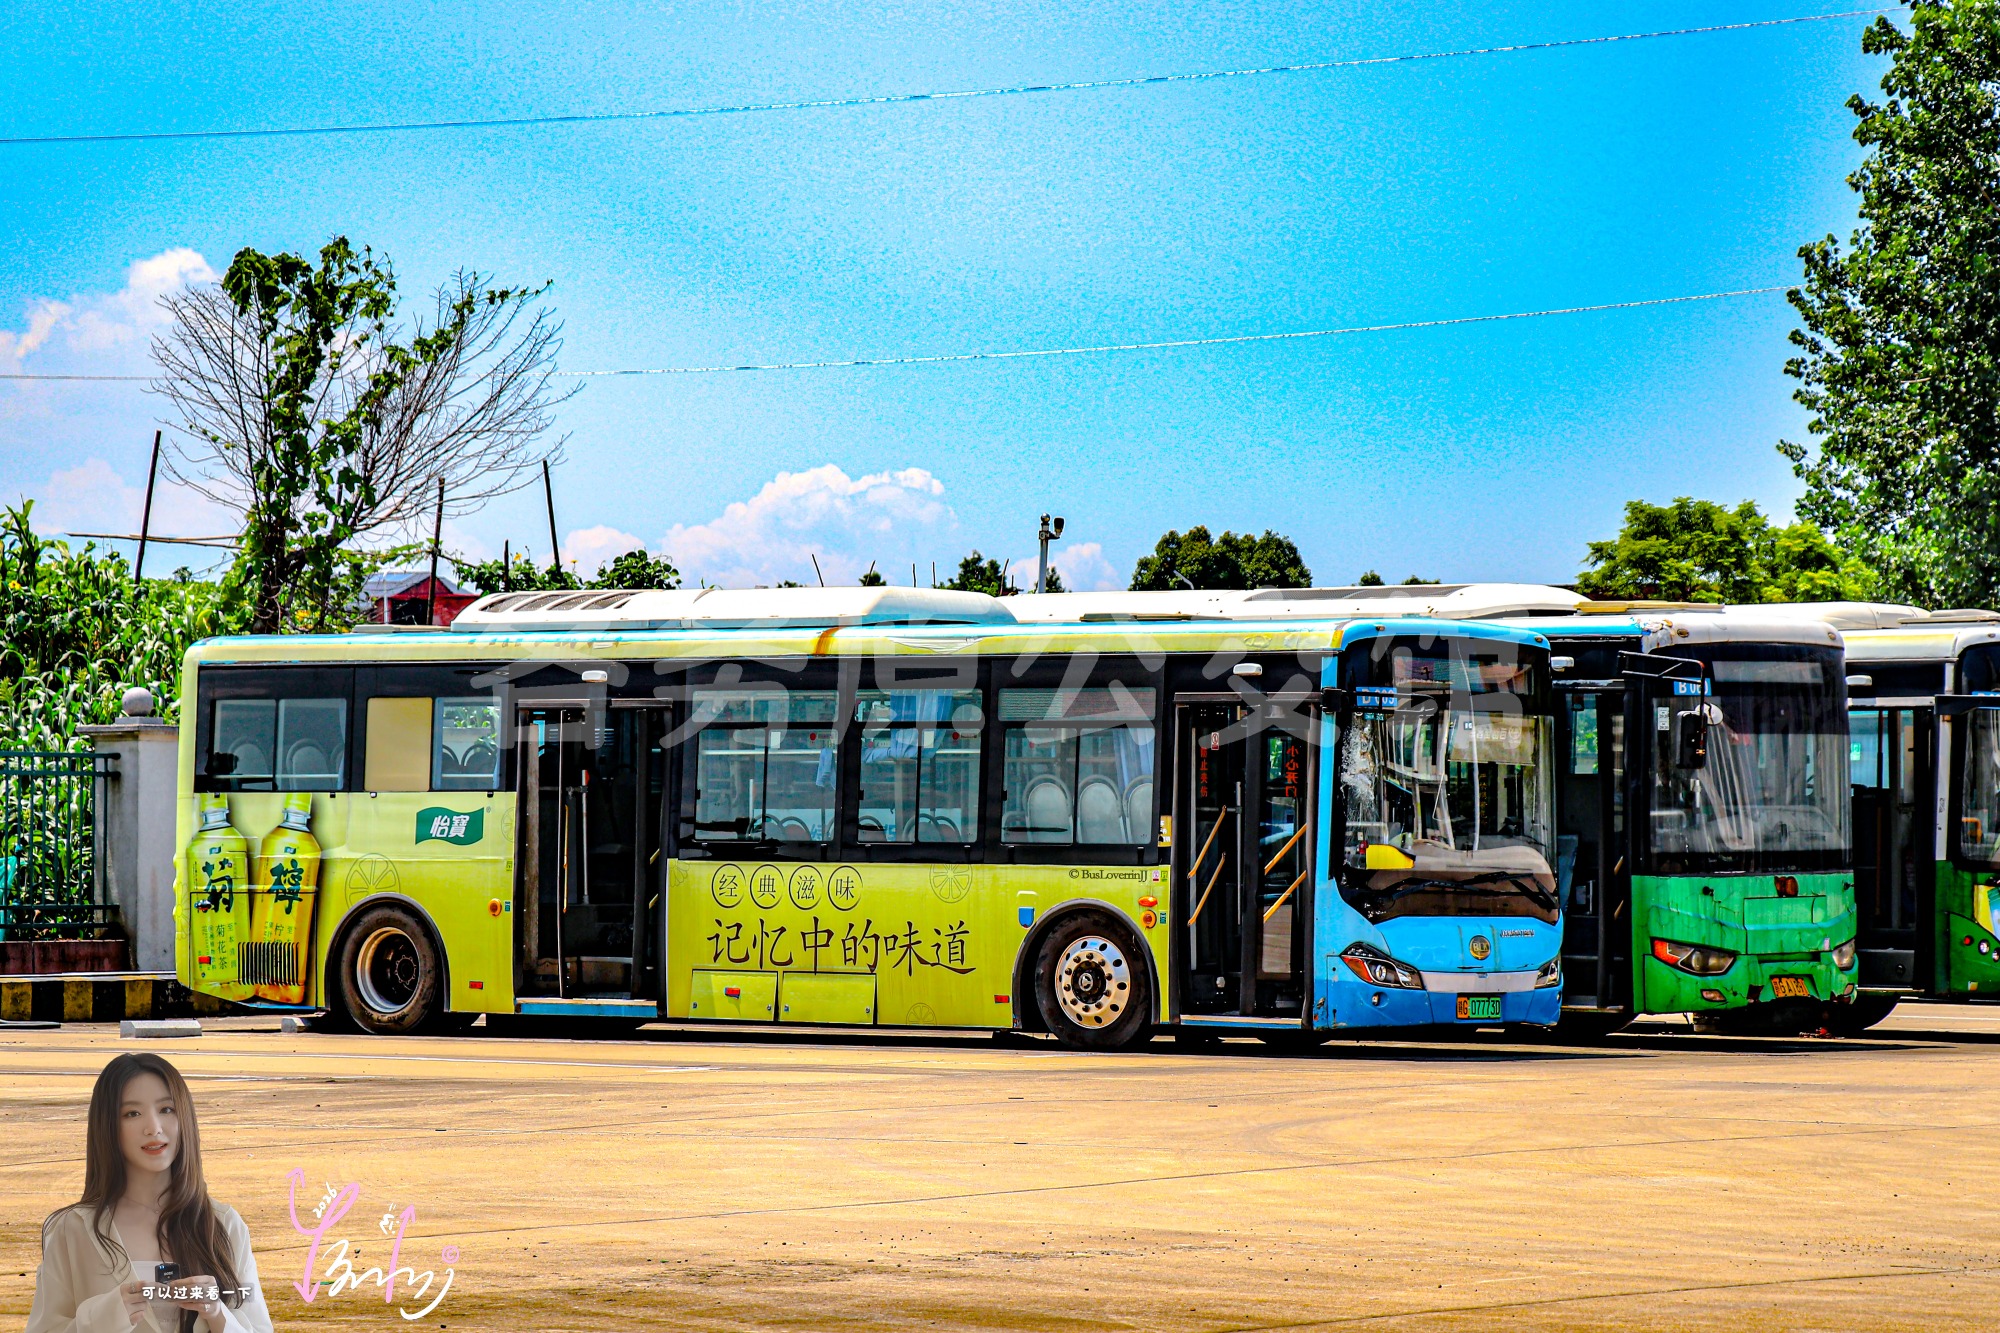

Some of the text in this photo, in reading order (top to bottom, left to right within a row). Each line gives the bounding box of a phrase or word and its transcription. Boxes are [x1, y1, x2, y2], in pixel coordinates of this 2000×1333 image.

[429, 814, 470, 838] 怡寶
[717, 873, 856, 901] 经典滋味
[706, 915, 977, 977] 记忆中的味道
